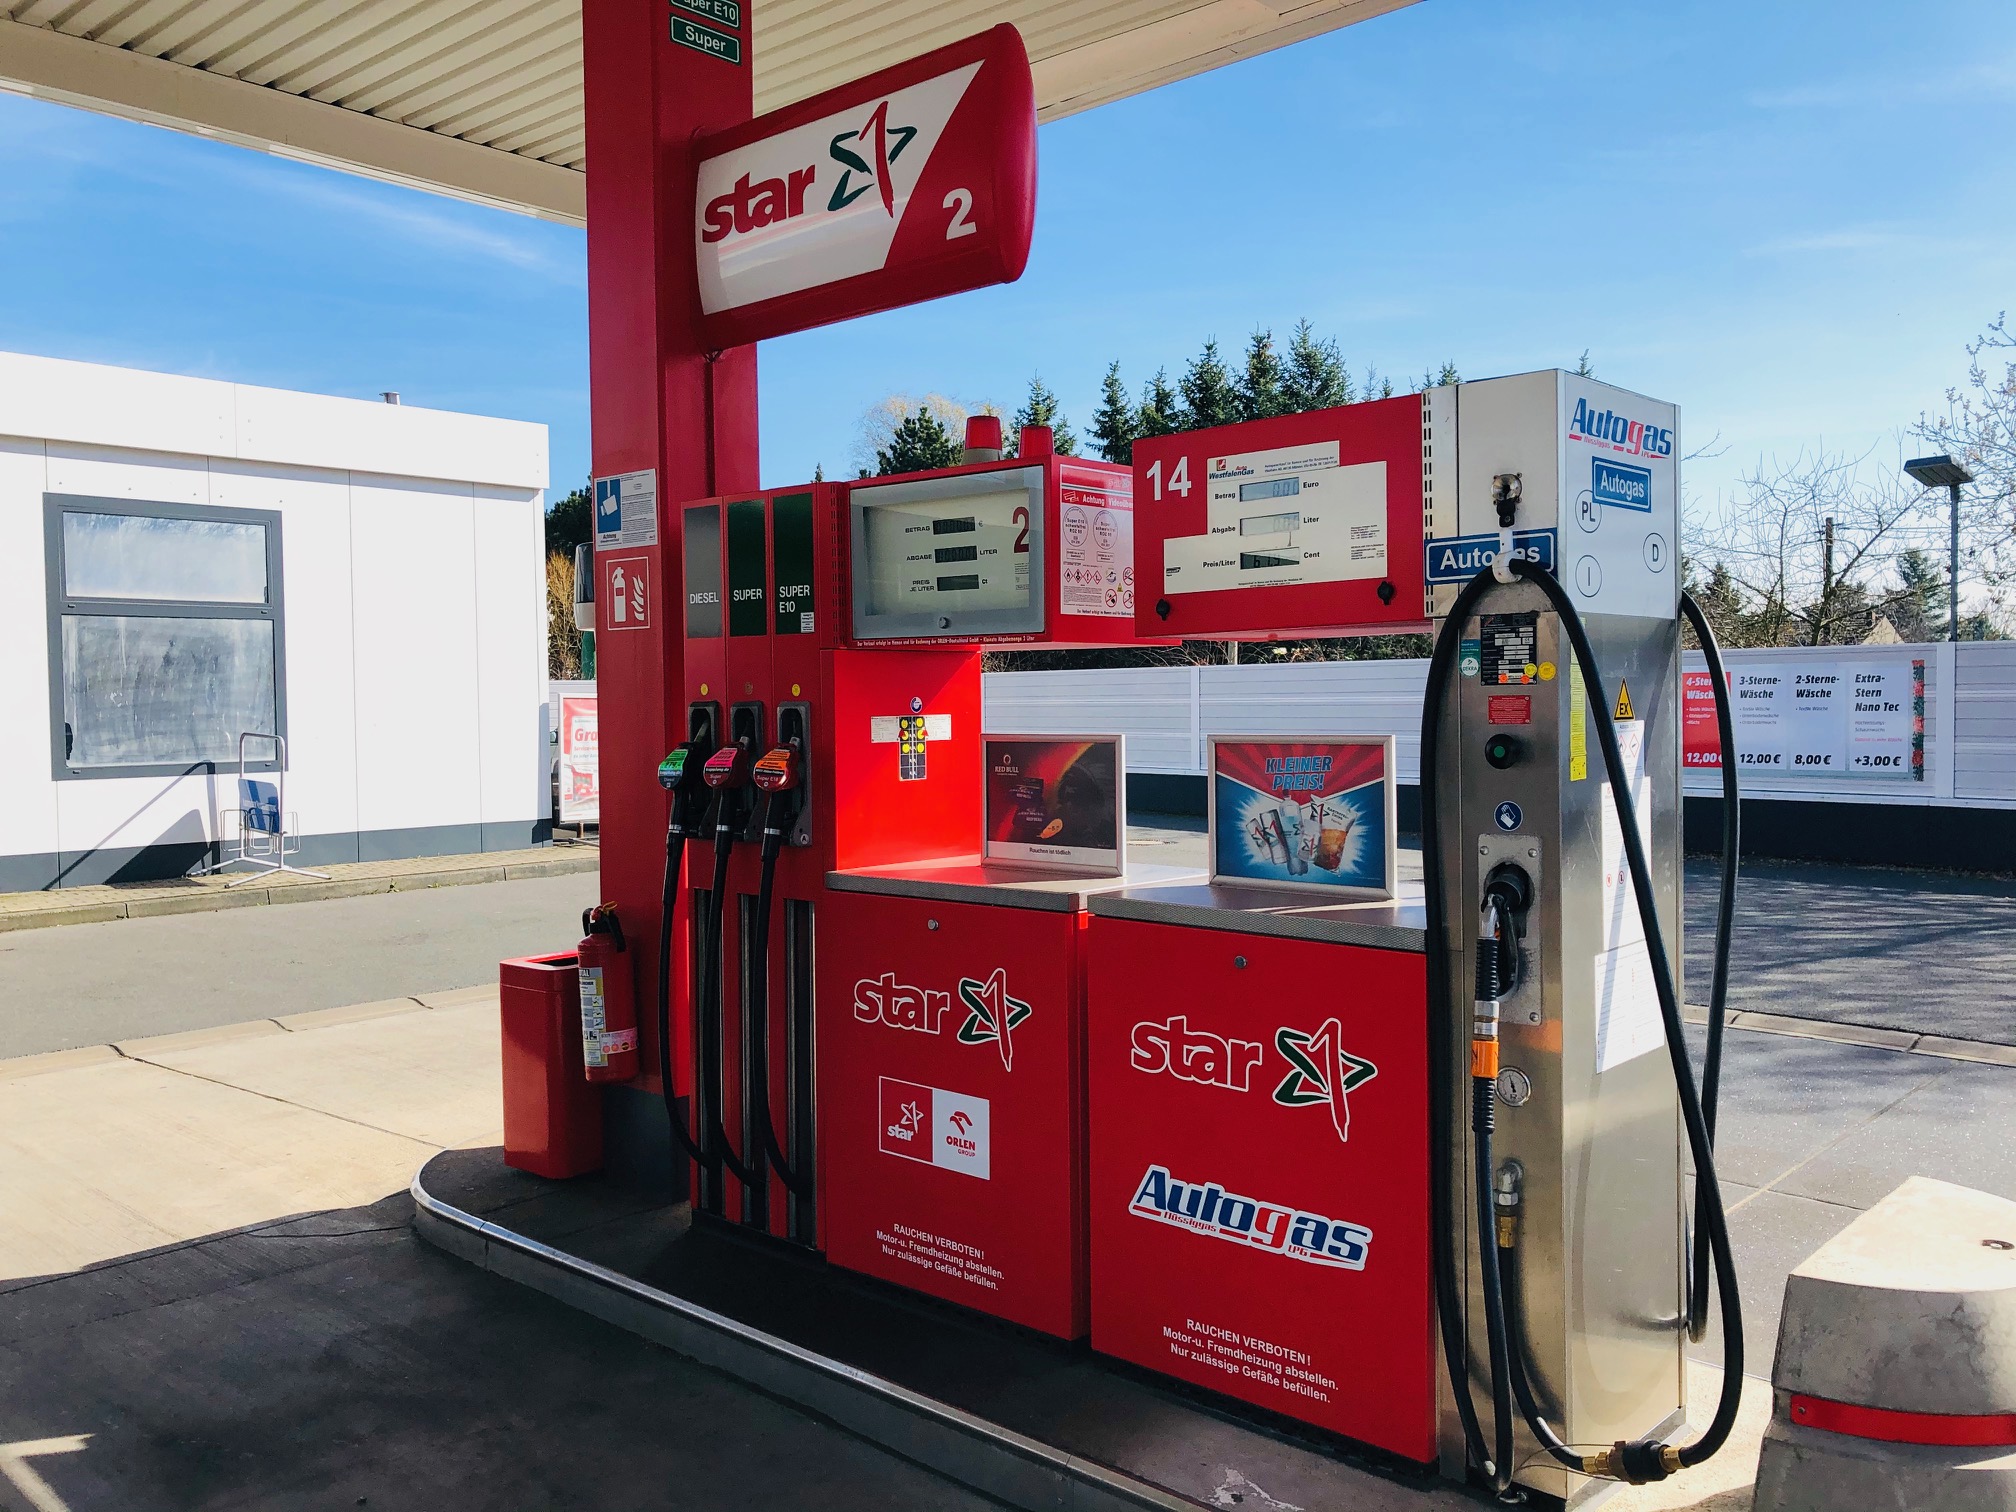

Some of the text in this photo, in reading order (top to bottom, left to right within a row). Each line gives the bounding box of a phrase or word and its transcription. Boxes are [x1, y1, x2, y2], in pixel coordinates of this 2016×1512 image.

[714, 1, 736, 21] E10
[685, 25, 726, 52] Super
[702, 164, 816, 243] star
[942, 187, 978, 241] 2
[1570, 397, 1673, 456] Autogas
[1146, 456, 1192, 501] 14
[1209, 468, 1255, 480] WestfalenGas
[1303, 481, 1319, 489] Euro
[1601, 470, 1645, 501] Autogas
[1082, 494, 1105, 506] Achtung
[1214, 492, 1236, 500] Betrag
[1582, 501, 1596, 522] PL
[1303, 516, 1320, 524] Liter
[905, 525, 930, 533] BETRAG
[1012, 507, 1030, 553] 2
[1211, 526, 1236, 534] Abgabe
[1303, 551, 1320, 559] Cent
[1440, 547, 1541, 570] Autoas
[1652, 543, 1659, 562] D
[1203, 560, 1236, 568] Preis/Liter
[689, 592, 719, 604] DIESEL
[733, 588, 763, 601] SUPER
[779, 585, 810, 598] SUPER
[779, 601, 796, 613] E10
[1739, 676, 1781, 685] 3-Sterne-
[1795, 675, 1840, 684] 2-Sterne-
[1855, 674, 1885, 683] Extra-
[1686, 690, 1715, 699] Wäsch
[1740, 689, 1774, 699] Wäsche
[1796, 689, 1832, 698] Wäsche
[1855, 688, 1882, 697] Stern
[1619, 703, 1628, 715] EX
[1855, 702, 1900, 711] Nano Tec
[1265, 756, 1333, 773] KLEINER
[1686, 752, 1718, 764] 12,00
[1740, 753, 1781, 765] 12,00 €
[1794, 754, 1832, 766] 8,00 €
[1854, 756, 1902, 767] +3,00 €
[1272, 773, 1326, 790] PREIS!
[854, 972, 950, 1035] star
[1131, 1015, 1262, 1092] star
[887, 1124, 914, 1141] star
[946, 1135, 976, 1150] ORLEN
[957, 1149, 976, 1157] GROUP
[1136, 1169, 1368, 1262] Autogas
[893, 1223, 933, 1243] RAUCHEN
[876, 1230, 1005, 1280] Motor-u. Fremdheizung abstellen.
[882, 1244, 999, 1291] Nur zulässige Gefäße befüllen.
[1186, 1318, 1240, 1344] RAUCHEN
[1163, 1326, 1339, 1390] Motor-u. Fremdheizung abstellen.
[1170, 1343, 1331, 1403] Nur zulässige Gefäße befüllen.
